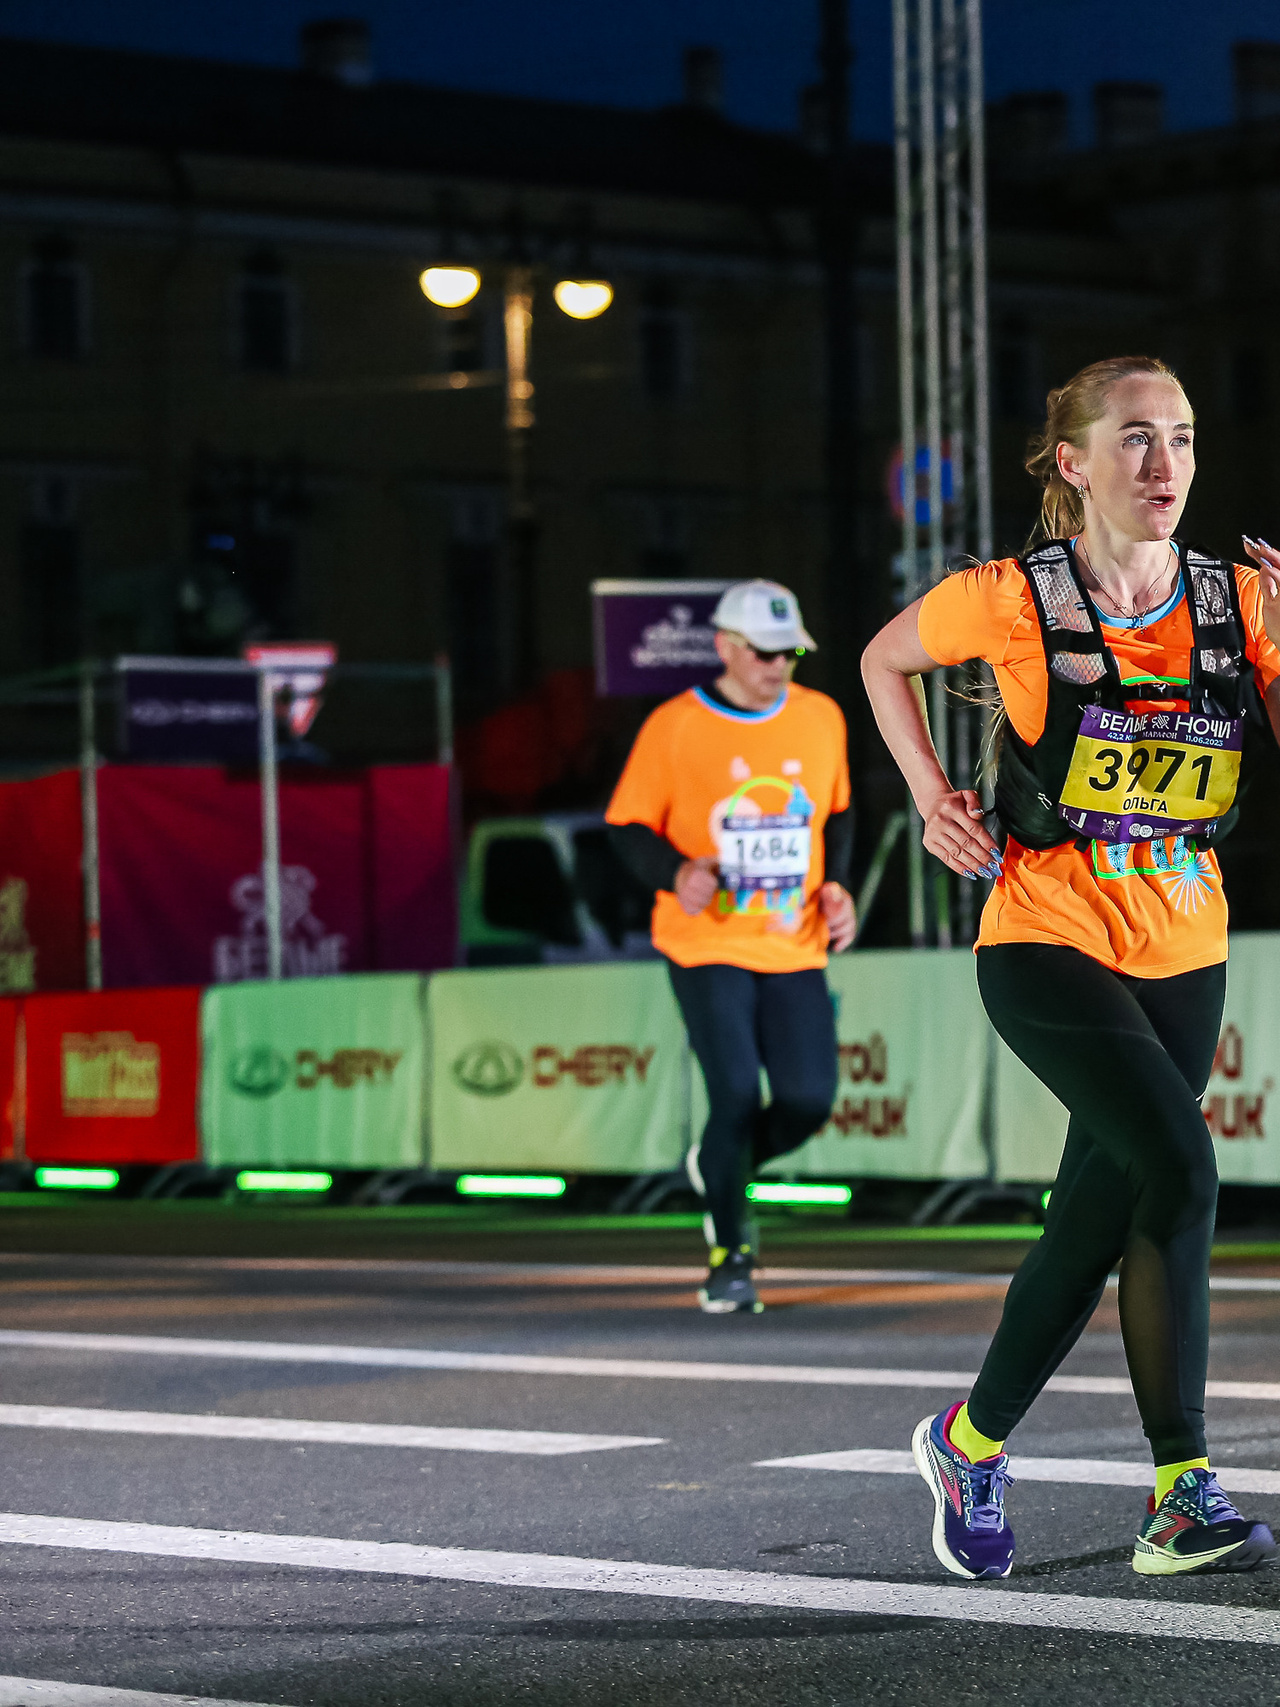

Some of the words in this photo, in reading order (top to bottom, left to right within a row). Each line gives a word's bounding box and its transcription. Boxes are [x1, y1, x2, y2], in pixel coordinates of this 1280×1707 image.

[1099, 712, 1149, 734] БЕЛЫЕ
[1175, 714, 1232, 739] НОЧИ
[1142, 731, 1178, 740] МАРАФОН
[1185, 734, 1224, 748] 11.06.2023
[1088, 747, 1214, 802] 3971
[1122, 796, 1169, 815] ОЛЬГА
[735, 837, 800, 864] 1684
[296, 1047, 403, 1090] CHERY
[532, 1043, 657, 1089] CHERY
